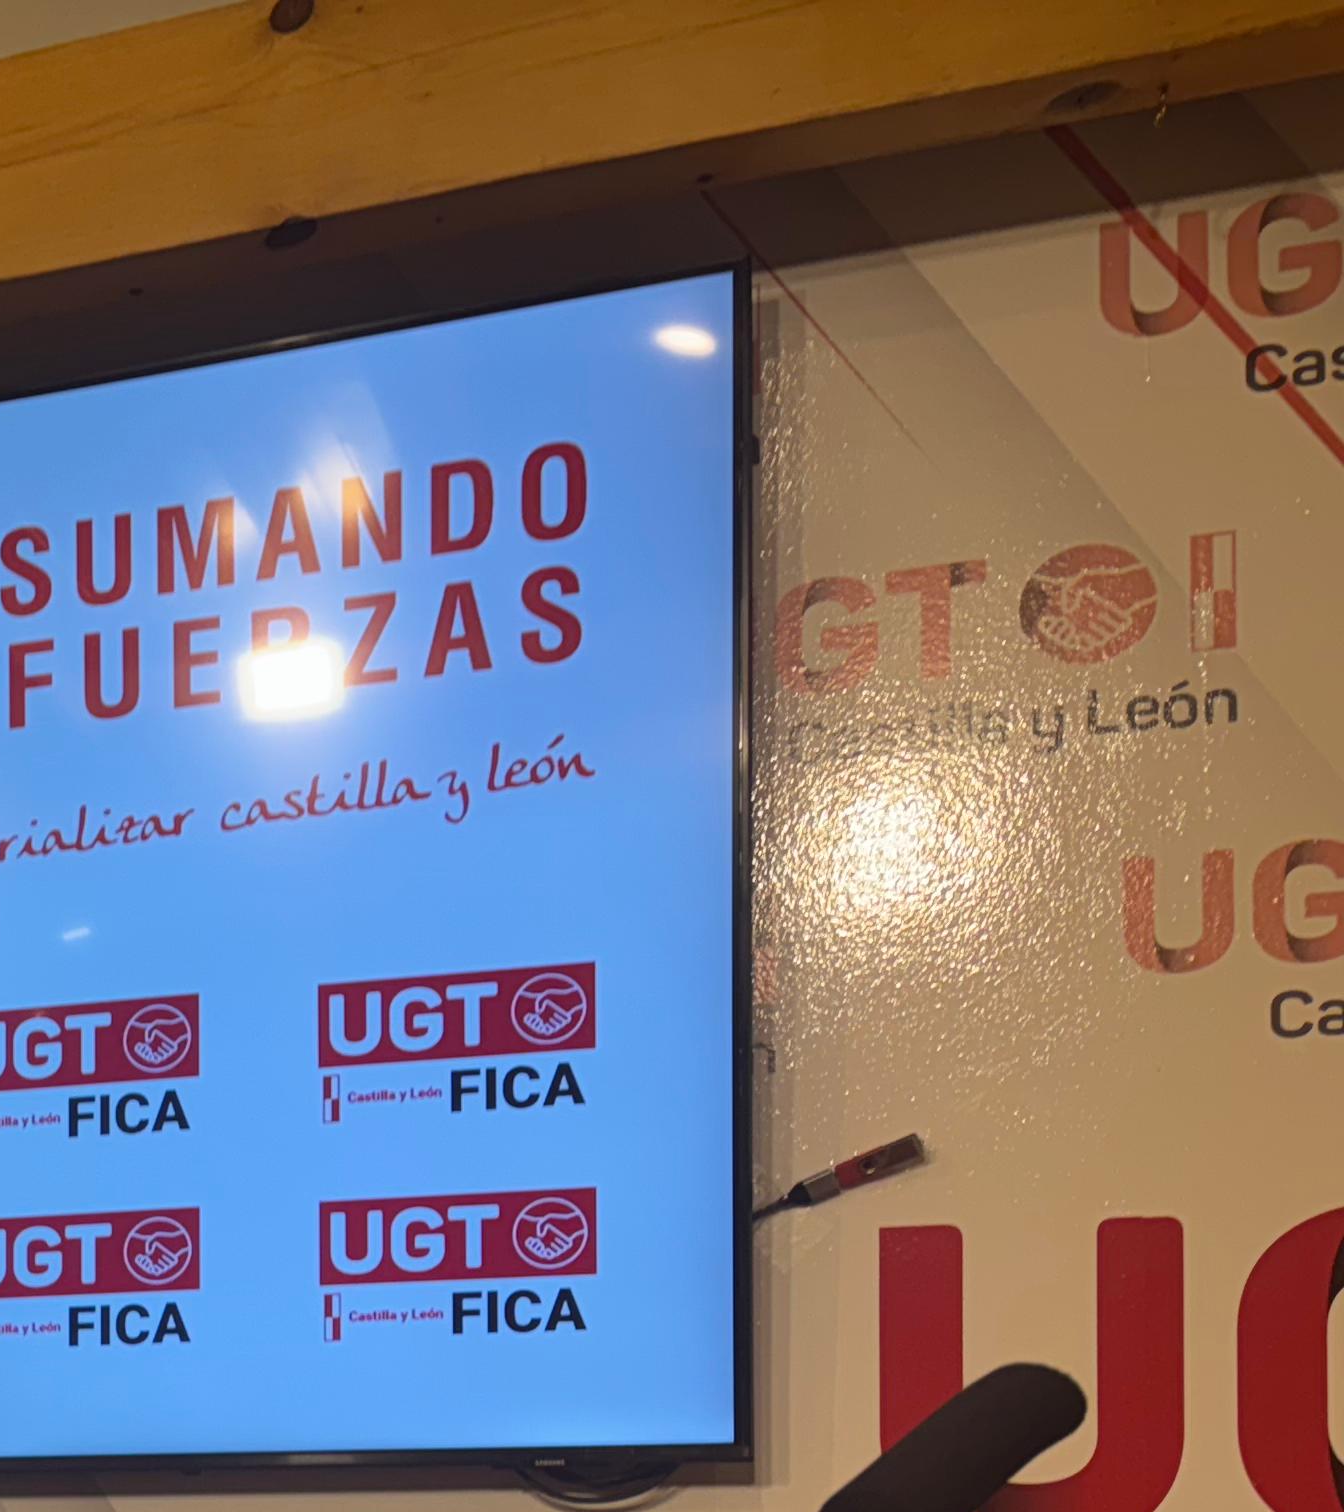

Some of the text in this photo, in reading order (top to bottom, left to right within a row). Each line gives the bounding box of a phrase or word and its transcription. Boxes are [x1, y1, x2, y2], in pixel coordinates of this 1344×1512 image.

[773, 556, 987, 696] GT
[1087, 679, 1239, 736] León
[220, 757, 428, 832] castilla
[437, 770, 471, 825] y
[486, 734, 596, 792] león
[329, 980, 499, 1058] UGT
[67, 1088, 191, 1139] FICA
[450, 1061, 586, 1114] FICA
[329, 1203, 501, 1277] UGT
[68, 1301, 191, 1348] FICA
[451, 1287, 587, 1336] FICA
